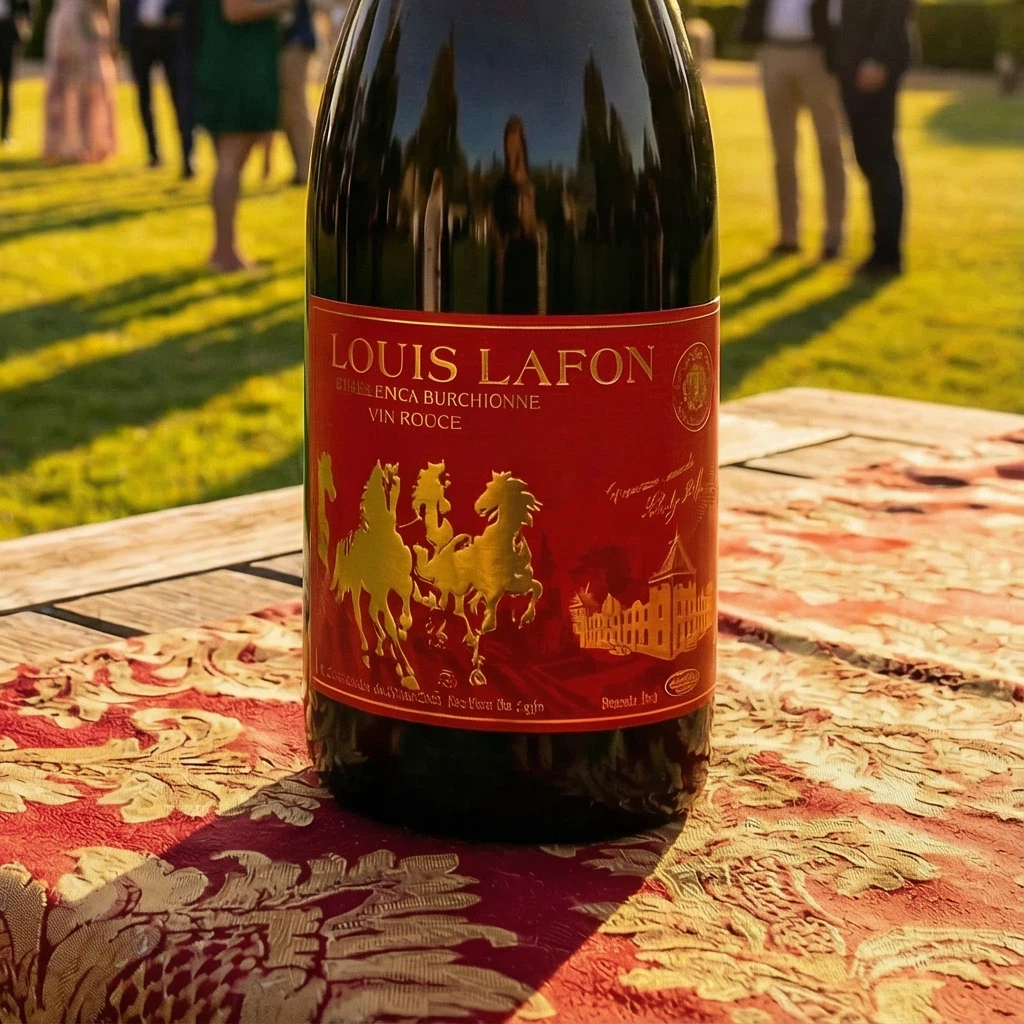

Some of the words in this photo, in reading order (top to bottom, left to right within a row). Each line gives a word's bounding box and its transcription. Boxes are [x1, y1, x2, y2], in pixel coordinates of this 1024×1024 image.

[331, 333, 458, 383] LOUIS
[478, 345, 655, 386] LAFON
[423, 390, 541, 410] BURCHIONNE
[368, 407, 395, 424] VIN
